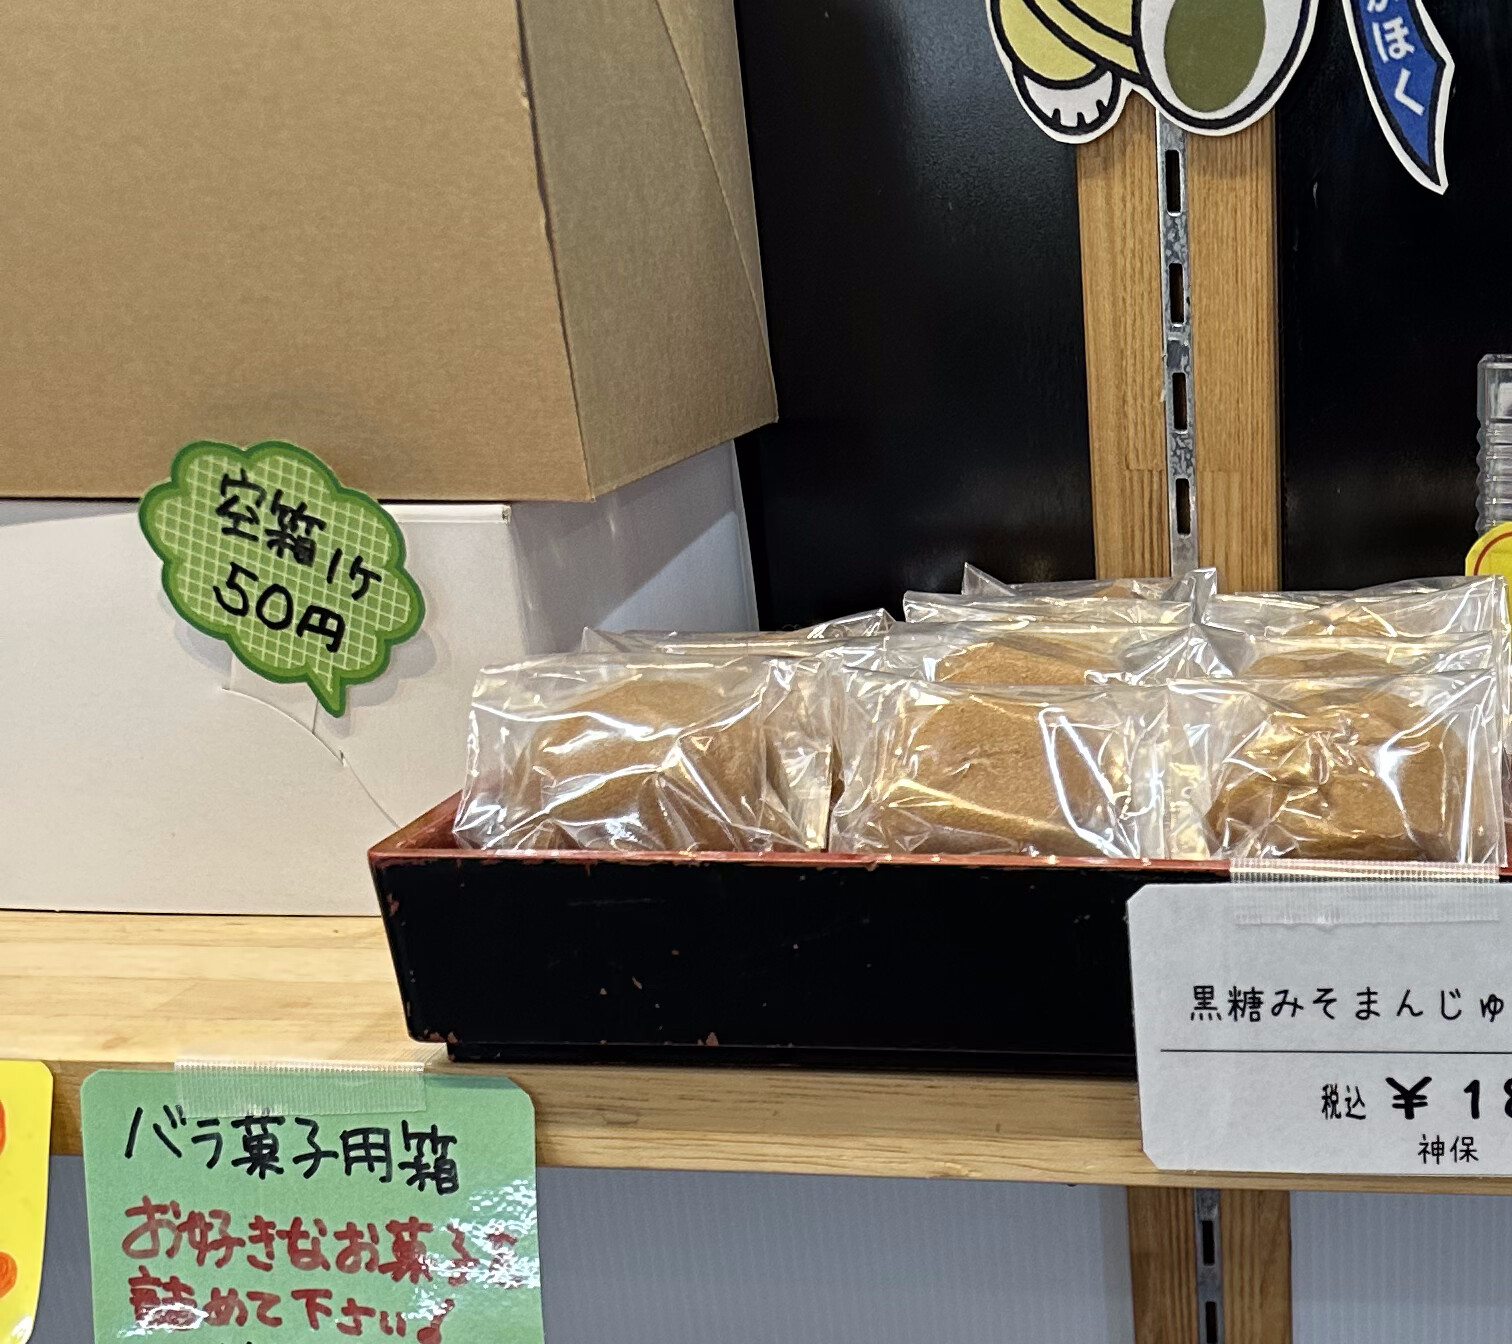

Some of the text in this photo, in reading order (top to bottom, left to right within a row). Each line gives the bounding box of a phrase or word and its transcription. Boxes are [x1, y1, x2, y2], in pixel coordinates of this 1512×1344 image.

[213, 562, 346, 653] 50円
[1321, 1083, 1368, 1121] 税込
[123, 1104, 461, 1196] バラ菓子用箱
[1417, 1133, 1480, 1165] 神保
